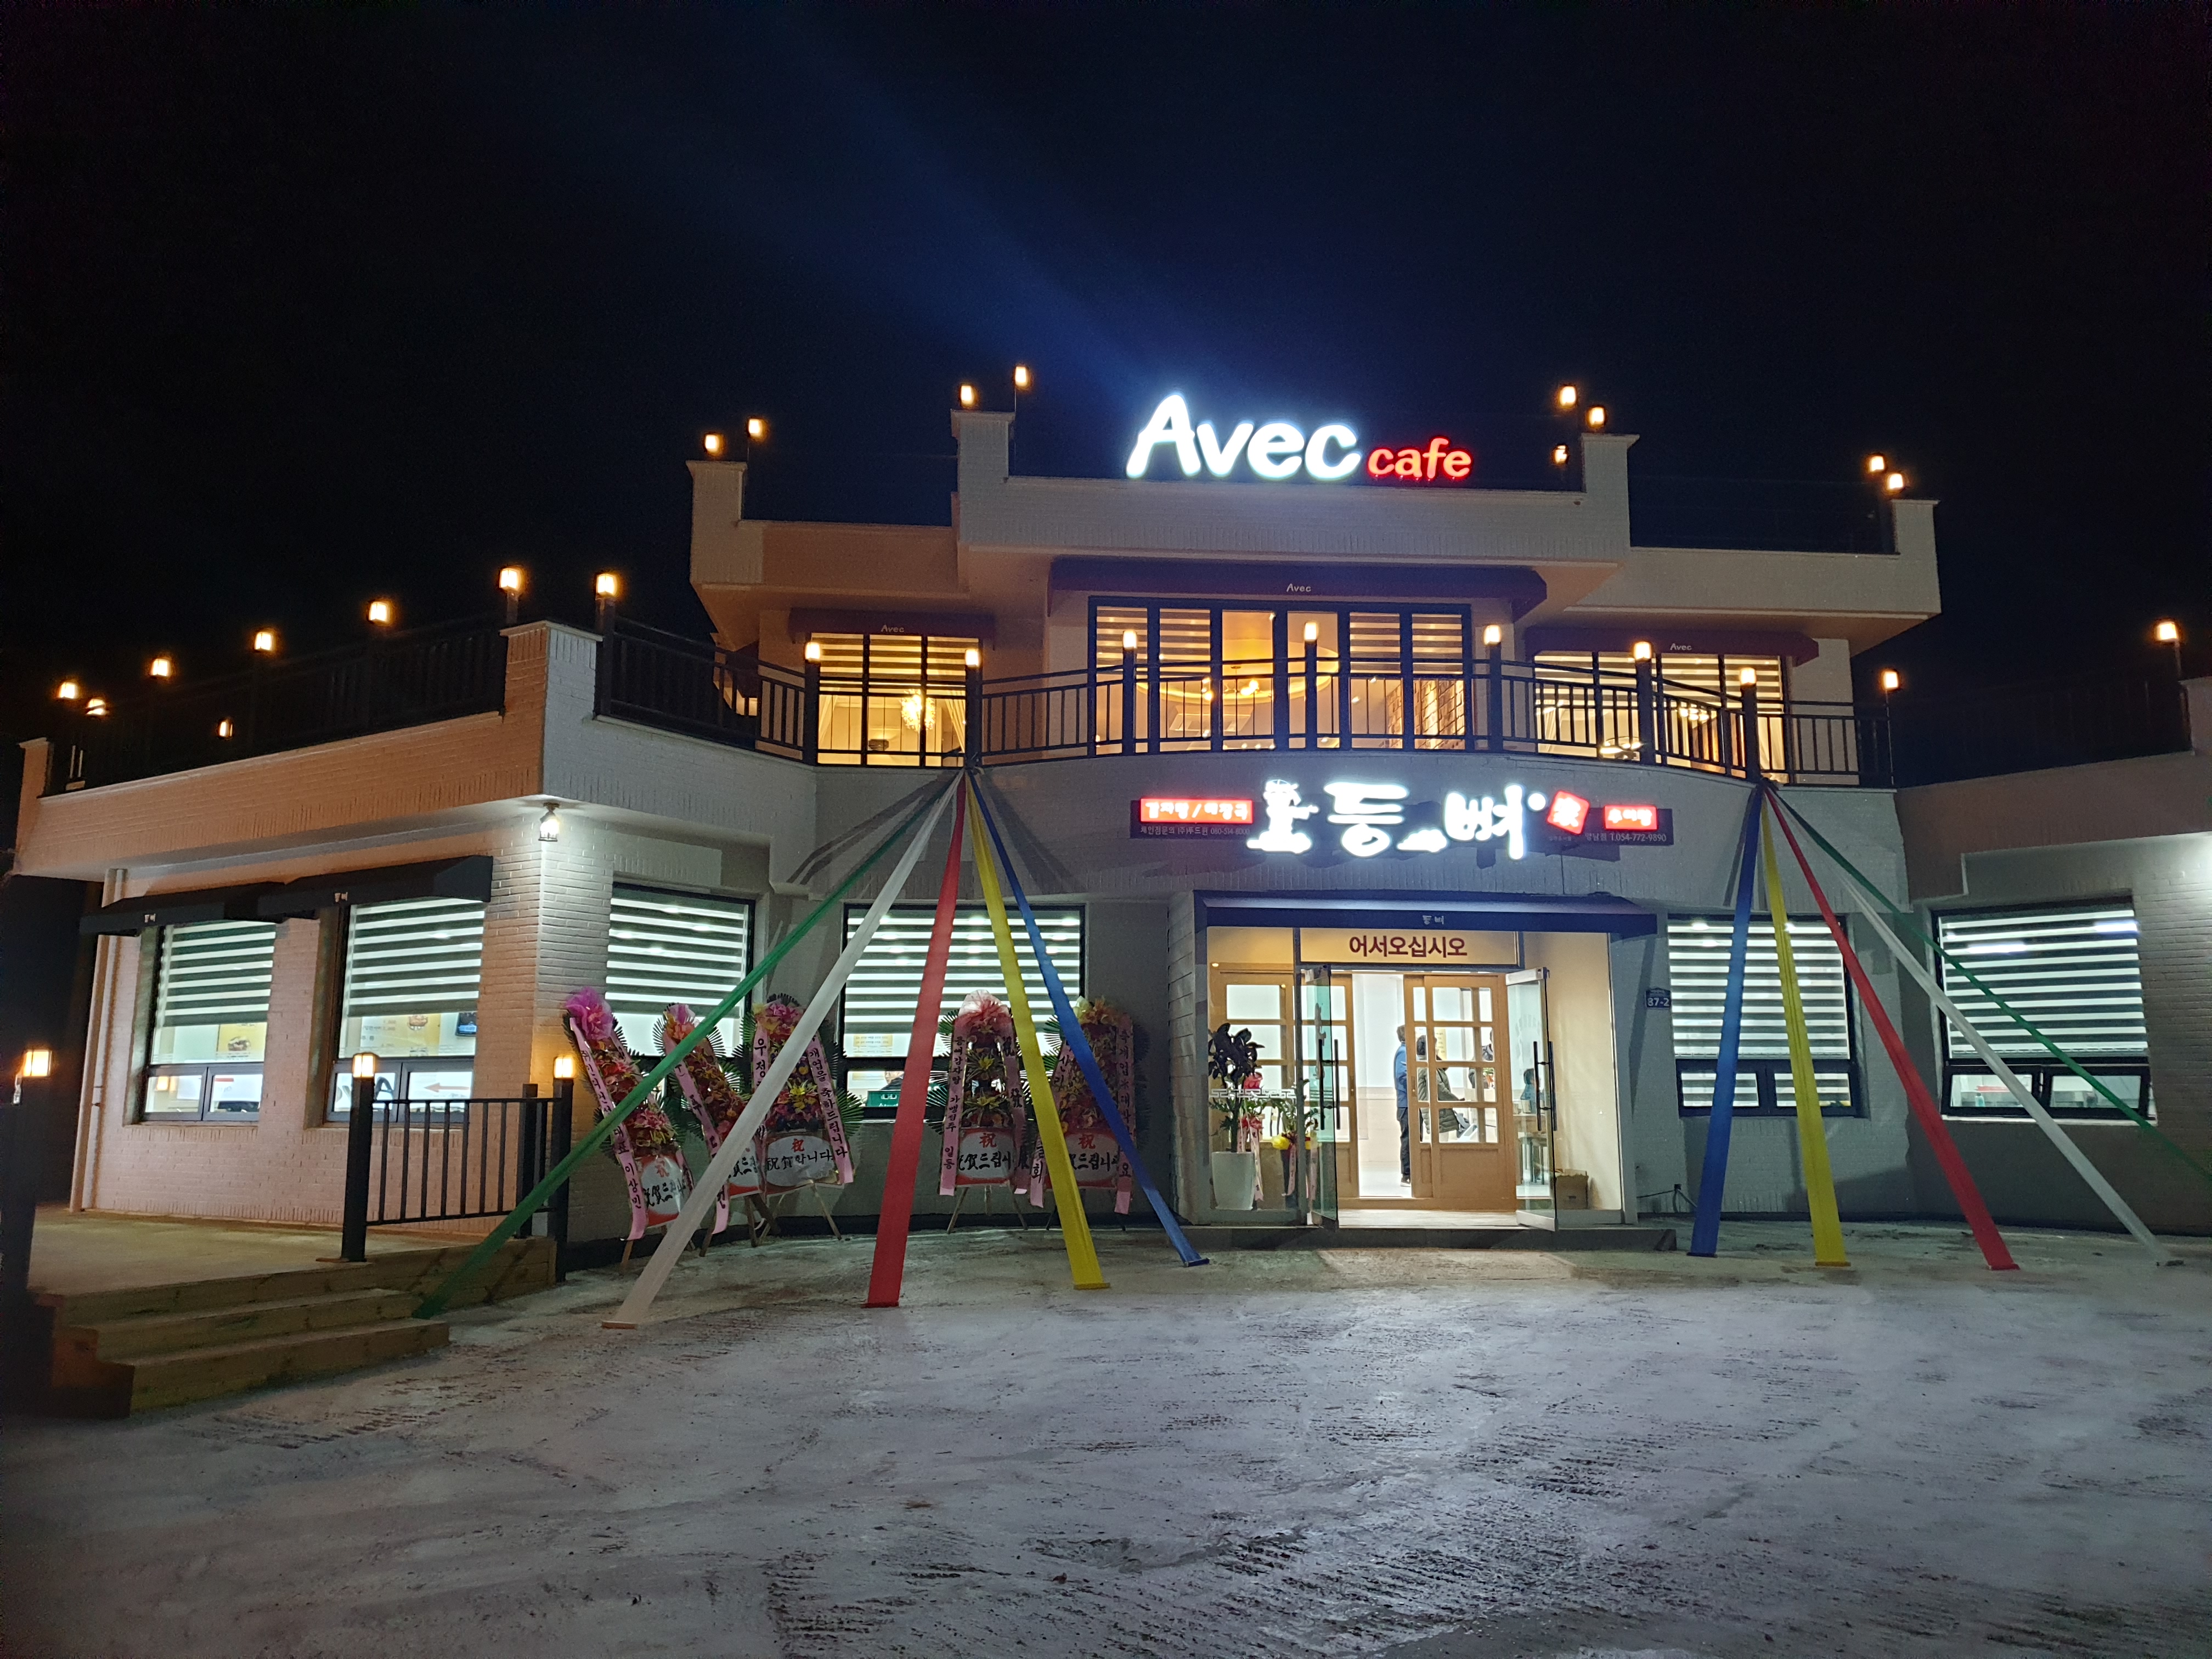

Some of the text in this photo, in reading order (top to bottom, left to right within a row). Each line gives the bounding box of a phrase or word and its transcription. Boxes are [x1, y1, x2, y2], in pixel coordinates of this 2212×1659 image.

[1126, 394, 1472, 479] Avec cafe
[1286, 583, 1311, 592] Avec
[881, 624, 905, 633] Avec
[1349, 935, 1468, 958] 어서오십시오
[1647, 997, 1669, 1007] 87-2
[809, 1048, 848, 1158] 개업을 축하드립니다
[979, 1132, 997, 1148] 祝
[1078, 1134, 1096, 1149] 祝
[613, 1126, 630, 1154] 대표
[624, 1163, 641, 1209] 이상민
[944, 1146, 955, 1170] 일동
